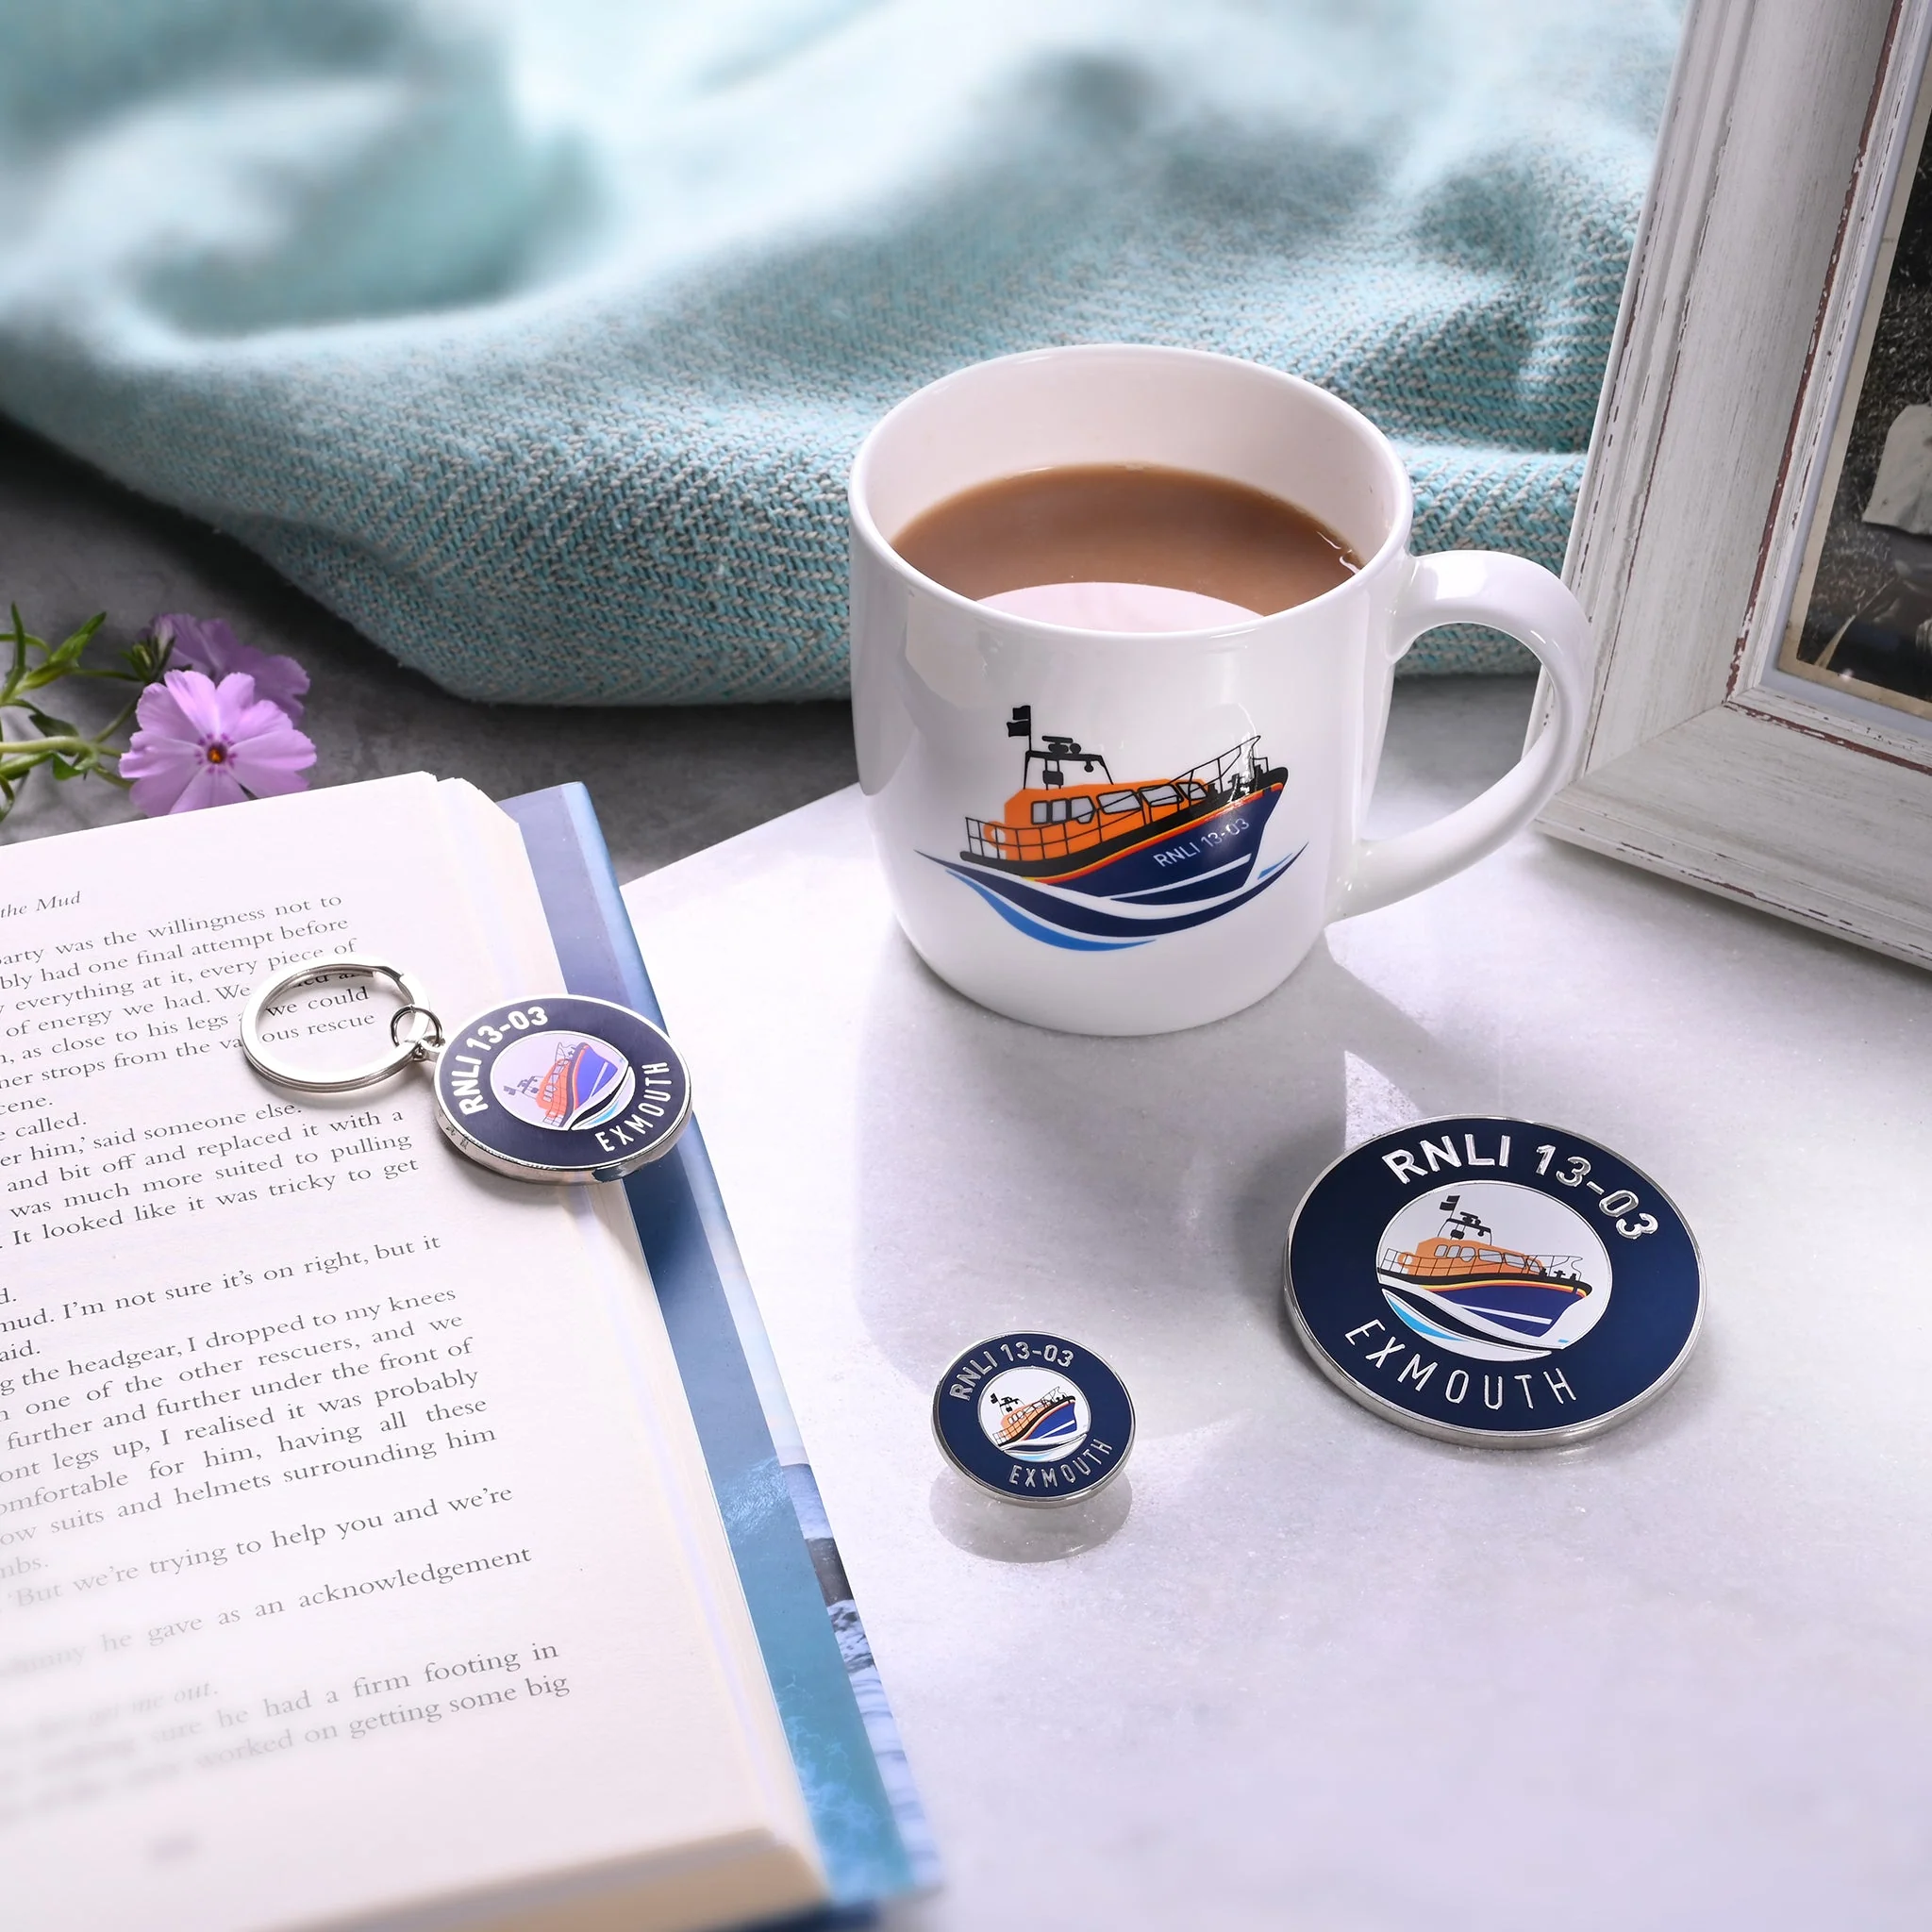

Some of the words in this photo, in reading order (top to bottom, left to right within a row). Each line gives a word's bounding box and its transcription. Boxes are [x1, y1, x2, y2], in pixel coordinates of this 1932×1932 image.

[1153, 842, 1201, 867] RNLI
[1201, 818, 1250, 847] 13-03
[1, 904, 26, 918] the
[37, 891, 80, 911] Mud
[56, 941, 93, 954] was
[104, 931, 136, 945] the
[147, 909, 265, 938] willingness
[275, 901, 310, 915] not
[321, 897, 341, 908] to
[16, 983, 134, 1010] everything
[143, 976, 161, 989] at
[172, 971, 192, 984] it,
[200, 960, 257, 978] every
[268, 950, 323, 971] piece
[334, 938, 357, 954] of
[41, 962, 81, 981] had
[89, 959, 128, 973] one
[138, 944, 184, 965] final
[192, 932, 274, 955] attempt
[280, 921, 348, 939] before
[7, 1020, 30, 1037] of
[39, 1010, 112, 1031] energy
[122, 1004, 153, 1015] we
[163, 991, 210, 1009] had.
[214, 984, 250, 999] We
[23, 1048, 42, 1058] as
[52, 1037, 106, 1053] close
[116, 1031, 137, 1041] to
[147, 1022, 178, 1037] his
[187, 1016, 228, 1031] legs
[265, 1003, 297, 1018] we
[308, 986, 370, 1010] could
[42, 1060, 105, 1081] strops
[114, 1051, 166, 1068] from
[175, 1042, 209, 1057] the
[308, 1015, 375, 1035] rescue
[467, 1006, 549, 1051] 13-03
[452, 1055, 489, 1115] RNLI
[594, 1061, 673, 1153] EXMOUTH
[8, 1170, 48, 1191] and
[58, 1164, 92, 1181] bit
[103, 1154, 136, 1173] off
[145, 1145, 186, 1165] and
[197, 1126, 291, 1157] replaced
[302, 1124, 319, 1137] it
[329, 1111, 382, 1131] with
[392, 1112, 403, 1121] a
[16, 1112, 86, 1137] called.
[93, 1128, 136, 1149] said
[144, 1114, 246, 1140] someone
[255, 1101, 302, 1123] else.
[9, 1202, 51, 1217] was
[64, 1183, 130, 1208] much
[142, 1174, 203, 1192] more
[215, 1154, 283, 1179] suited
[295, 1153, 318, 1164] to
[330, 1136, 412, 1162] pulling
[12, 1230, 32, 1245] It
[42, 1209, 124, 1239] looked
[134, 1203, 176, 1221] like
[189, 1195, 205, 1211] it
[215, 1191, 257, 1205] was
[269, 1174, 335, 1196] tricky
[348, 1170, 371, 1181] to
[384, 1159, 419, 1179] get
[1382, 1134, 1511, 1185] RNLI
[1536, 1144, 1658, 1240] 13-03
[115, 1291, 156, 1309] not
[165, 1282, 211, 1300] sure
[264, 1267, 294, 1280] on
[304, 1252, 368, 1274] right,
[374, 1242, 414, 1258] but
[424, 1235, 441, 1250] it
[22, 1368, 59, 1386] the
[68, 1344, 183, 1376] headgear,
[187, 1336, 198, 1353] I
[206, 1315, 306, 1348] dropped
[312, 1314, 336, 1326] to
[345, 1305, 380, 1321] my
[388, 1291, 456, 1311] knees
[25, 1396, 70, 1414] one
[87, 1381, 113, 1401] of
[125, 1375, 162, 1392] the
[179, 1360, 242, 1381] other
[258, 1339, 359, 1366] rescuers,
[372, 1321, 415, 1343] and
[428, 1317, 462, 1330] we
[950, 1351, 998, 1402] RNLI
[1000, 1341, 1074, 1368] 13-03
[1344, 1319, 1577, 1410] EXMOUTH
[8, 1421, 92, 1450] further
[103, 1404, 146, 1427] and
[157, 1390, 241, 1416] further
[251, 1373, 322, 1396] under
[332, 1362, 370, 1379] the
[379, 1349, 439, 1371] front
[448, 1337, 473, 1357] of
[52, 1450, 98, 1470] legs
[113, 1441, 150, 1458] up,
[160, 1429, 170, 1445] I
[185, 1407, 275, 1441] realised
[288, 1403, 306, 1419] it
[317, 1395, 361, 1412] was
[375, 1369, 478, 1407] probably
[149, 1460, 184, 1479] for
[203, 1448, 261, 1468] him,
[277, 1426, 362, 1452] having
[380, 1411, 408, 1432] all
[426, 1401, 487, 1422] these
[1008, 1439, 1113, 1488] EXMOUTH
[51, 1510, 104, 1533] suits
[118, 1492, 162, 1517] and
[174, 1475, 271, 1505] helmets
[284, 1442, 437, 1482] surrounding
[445, 1429, 496, 1449] him
[150, 1548, 227, 1574] trying
[235, 1541, 261, 1555] to
[271, 1524, 325, 1547] help
[335, 1516, 383, 1540] you
[393, 1498, 439, 1523] and
[100, 1634, 132, 1652] he
[148, 1619, 203, 1646] gave
[219, 1610, 241, 1624] as
[256, 1601, 285, 1616] an
[299, 1549, 531, 1607] acknowledgement
[175, 1683, 218, 1703] out.
[195, 1728, 294, 1769] worked
[305, 1725, 338, 1742] on
[349, 1704, 441, 1739] getting
[449, 1689, 516, 1712] some
[525, 1678, 570, 1697] big
[216, 1708, 249, 1729] he
[263, 1690, 311, 1717] had
[326, 1690, 340, 1703] a
[353, 1675, 411, 1697] firm
[425, 1654, 521, 1682] footing
[533, 1643, 558, 1660] in
